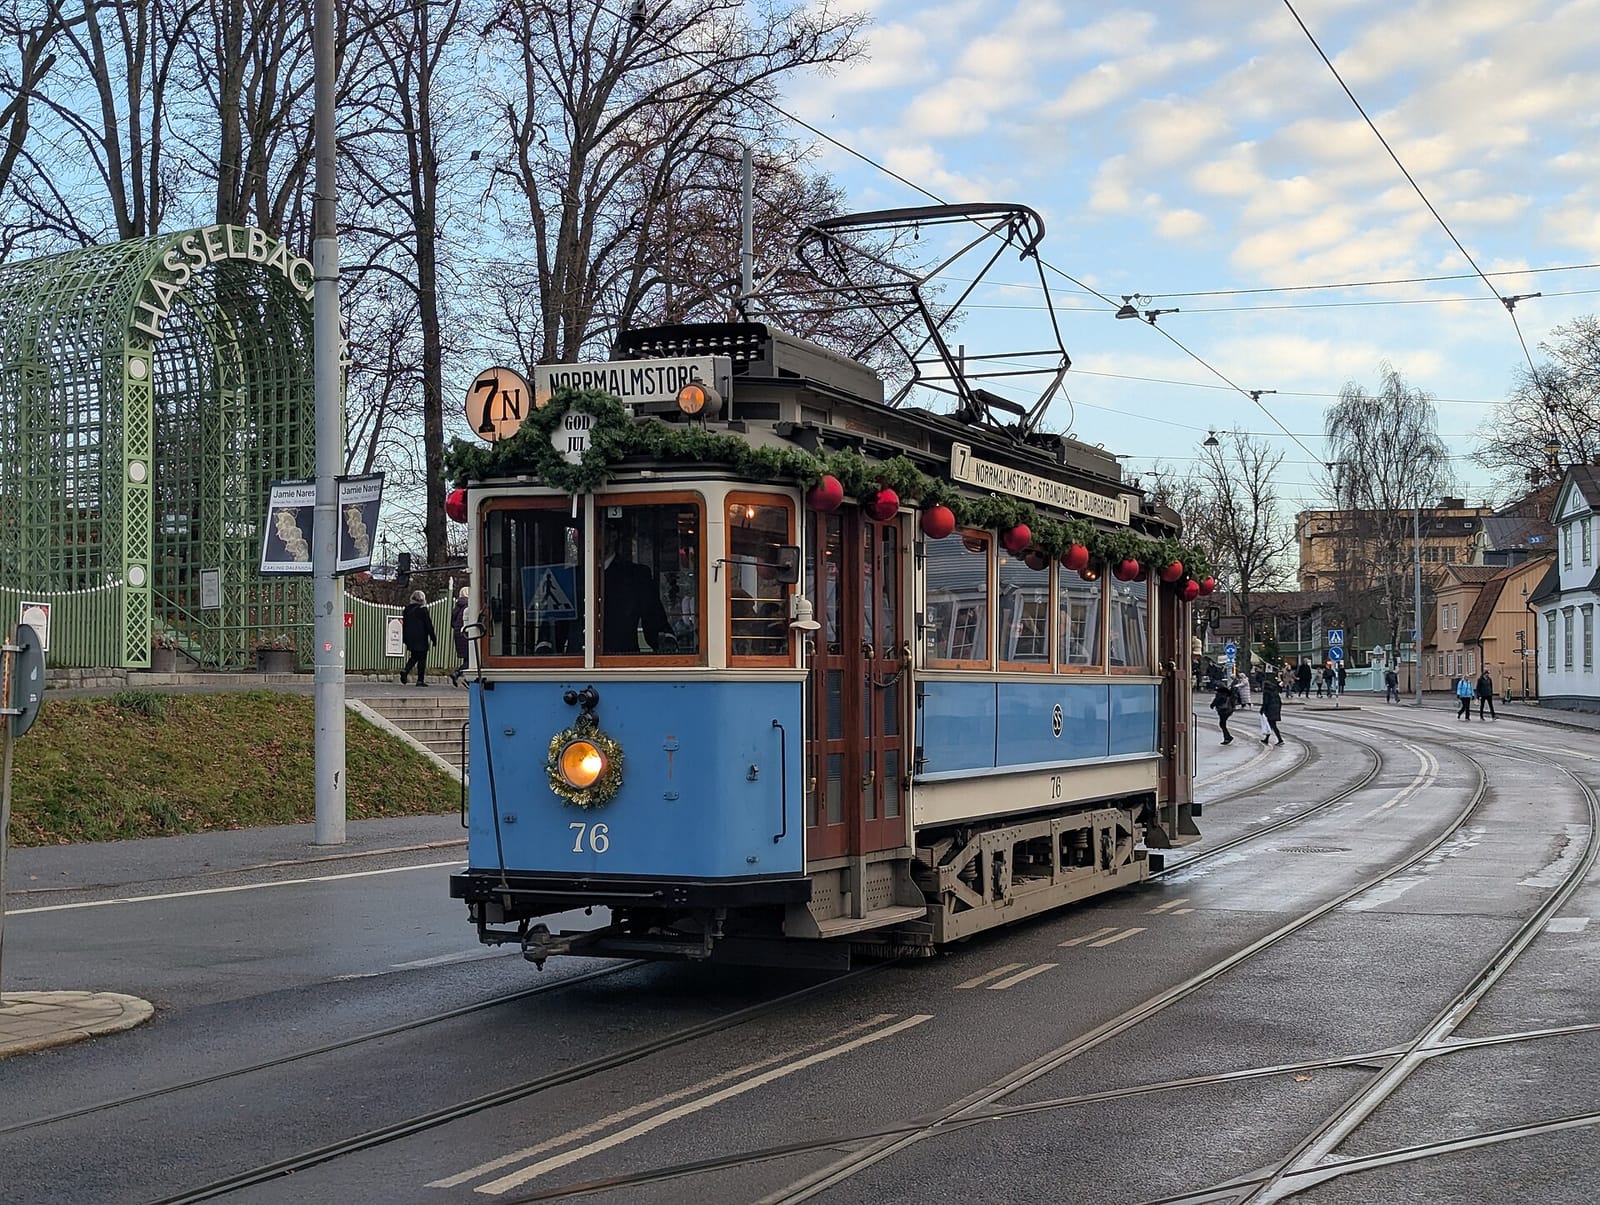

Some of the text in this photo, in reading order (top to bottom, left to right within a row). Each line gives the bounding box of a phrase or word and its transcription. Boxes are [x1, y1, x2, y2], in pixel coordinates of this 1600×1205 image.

[135, 224, 353, 366] HASSELBAC
[564, 415, 590, 430] GOD
[567, 436, 586, 454] JUL
[273, 489, 315, 499] Jamie Nares
[341, 486, 362, 495] Jamie
[959, 449, 966, 476] 7
[975, 463, 1032, 495] NORRMALMSTORG
[1123, 499, 1128, 520] 7
[1050, 776, 1062, 799] 76
[568, 822, 610, 854] 76
